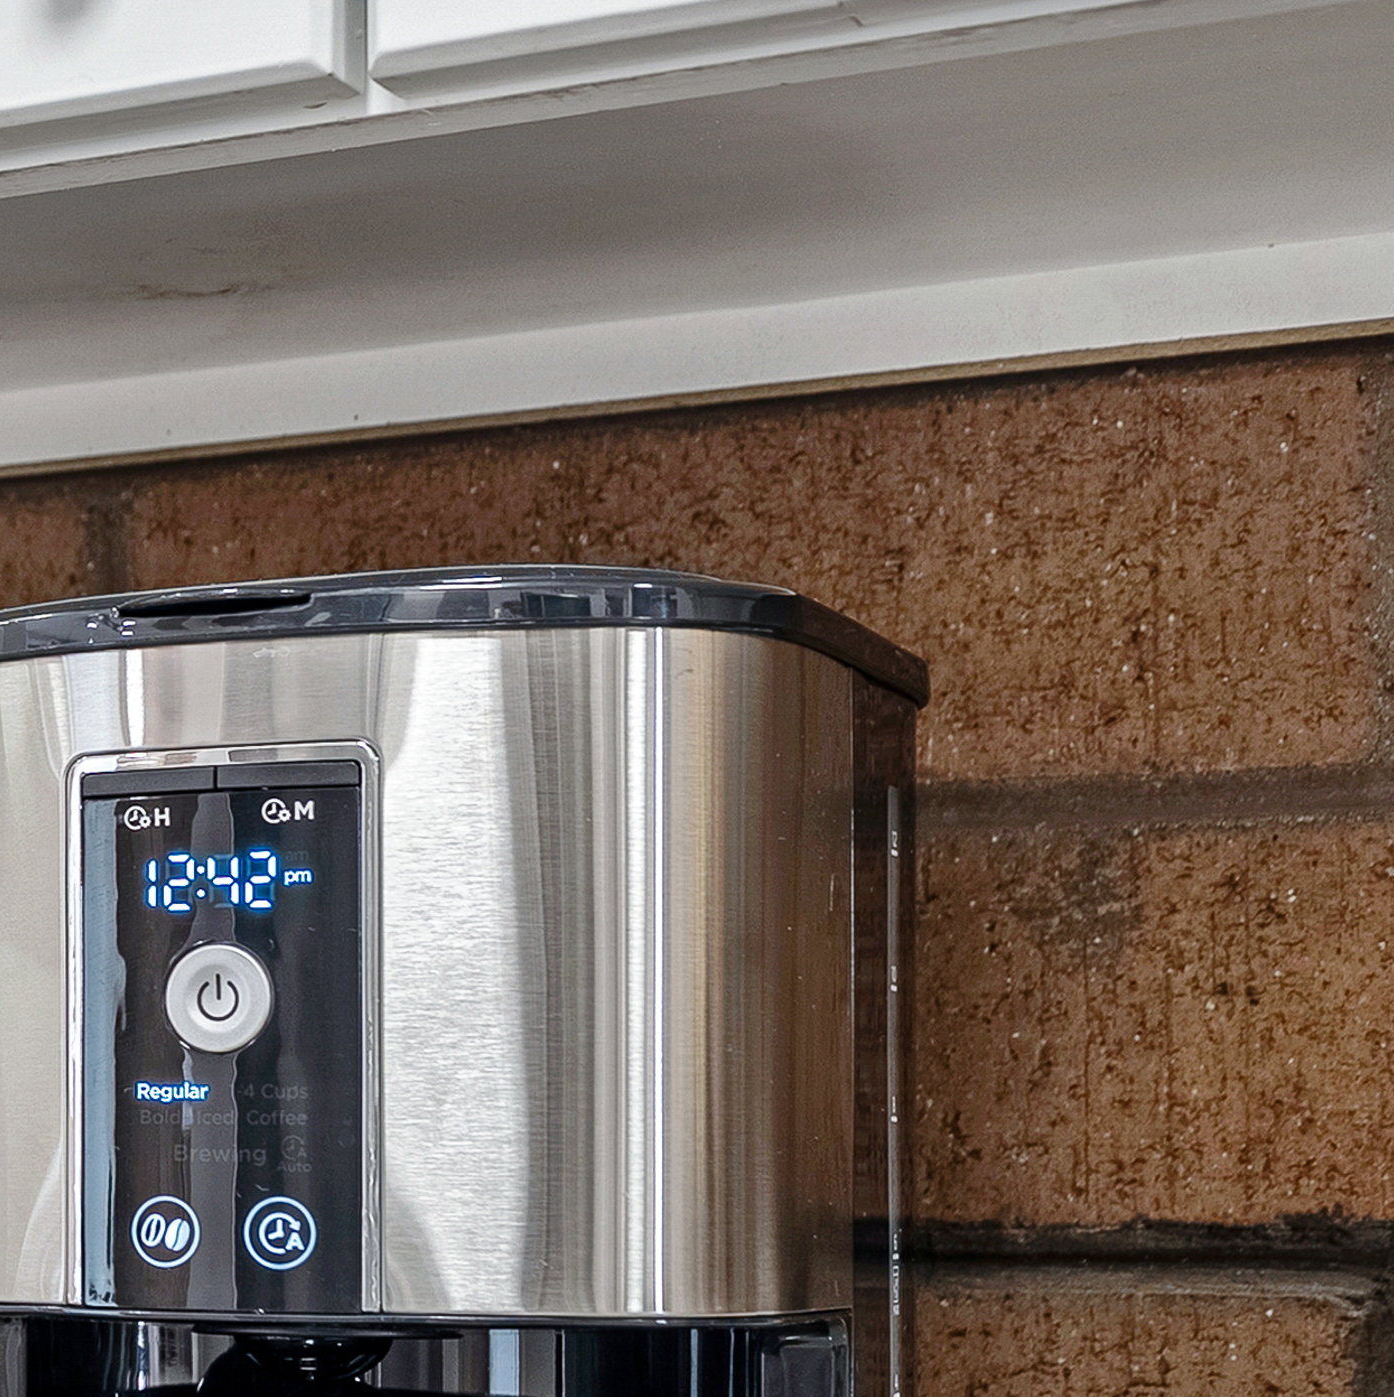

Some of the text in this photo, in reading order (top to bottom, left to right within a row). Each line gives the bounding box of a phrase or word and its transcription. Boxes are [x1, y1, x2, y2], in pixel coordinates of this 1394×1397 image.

[154, 806, 171, 827] H
[294, 800, 315, 820] M
[147, 850, 312, 911] 12:42 pm
[136, 1081, 209, 1103] Regular
[260, 1081, 309, 1102] Cups
[139, 1109, 309, 1126] Bold Iced Coffee
[173, 1143, 267, 1168] Brewing
